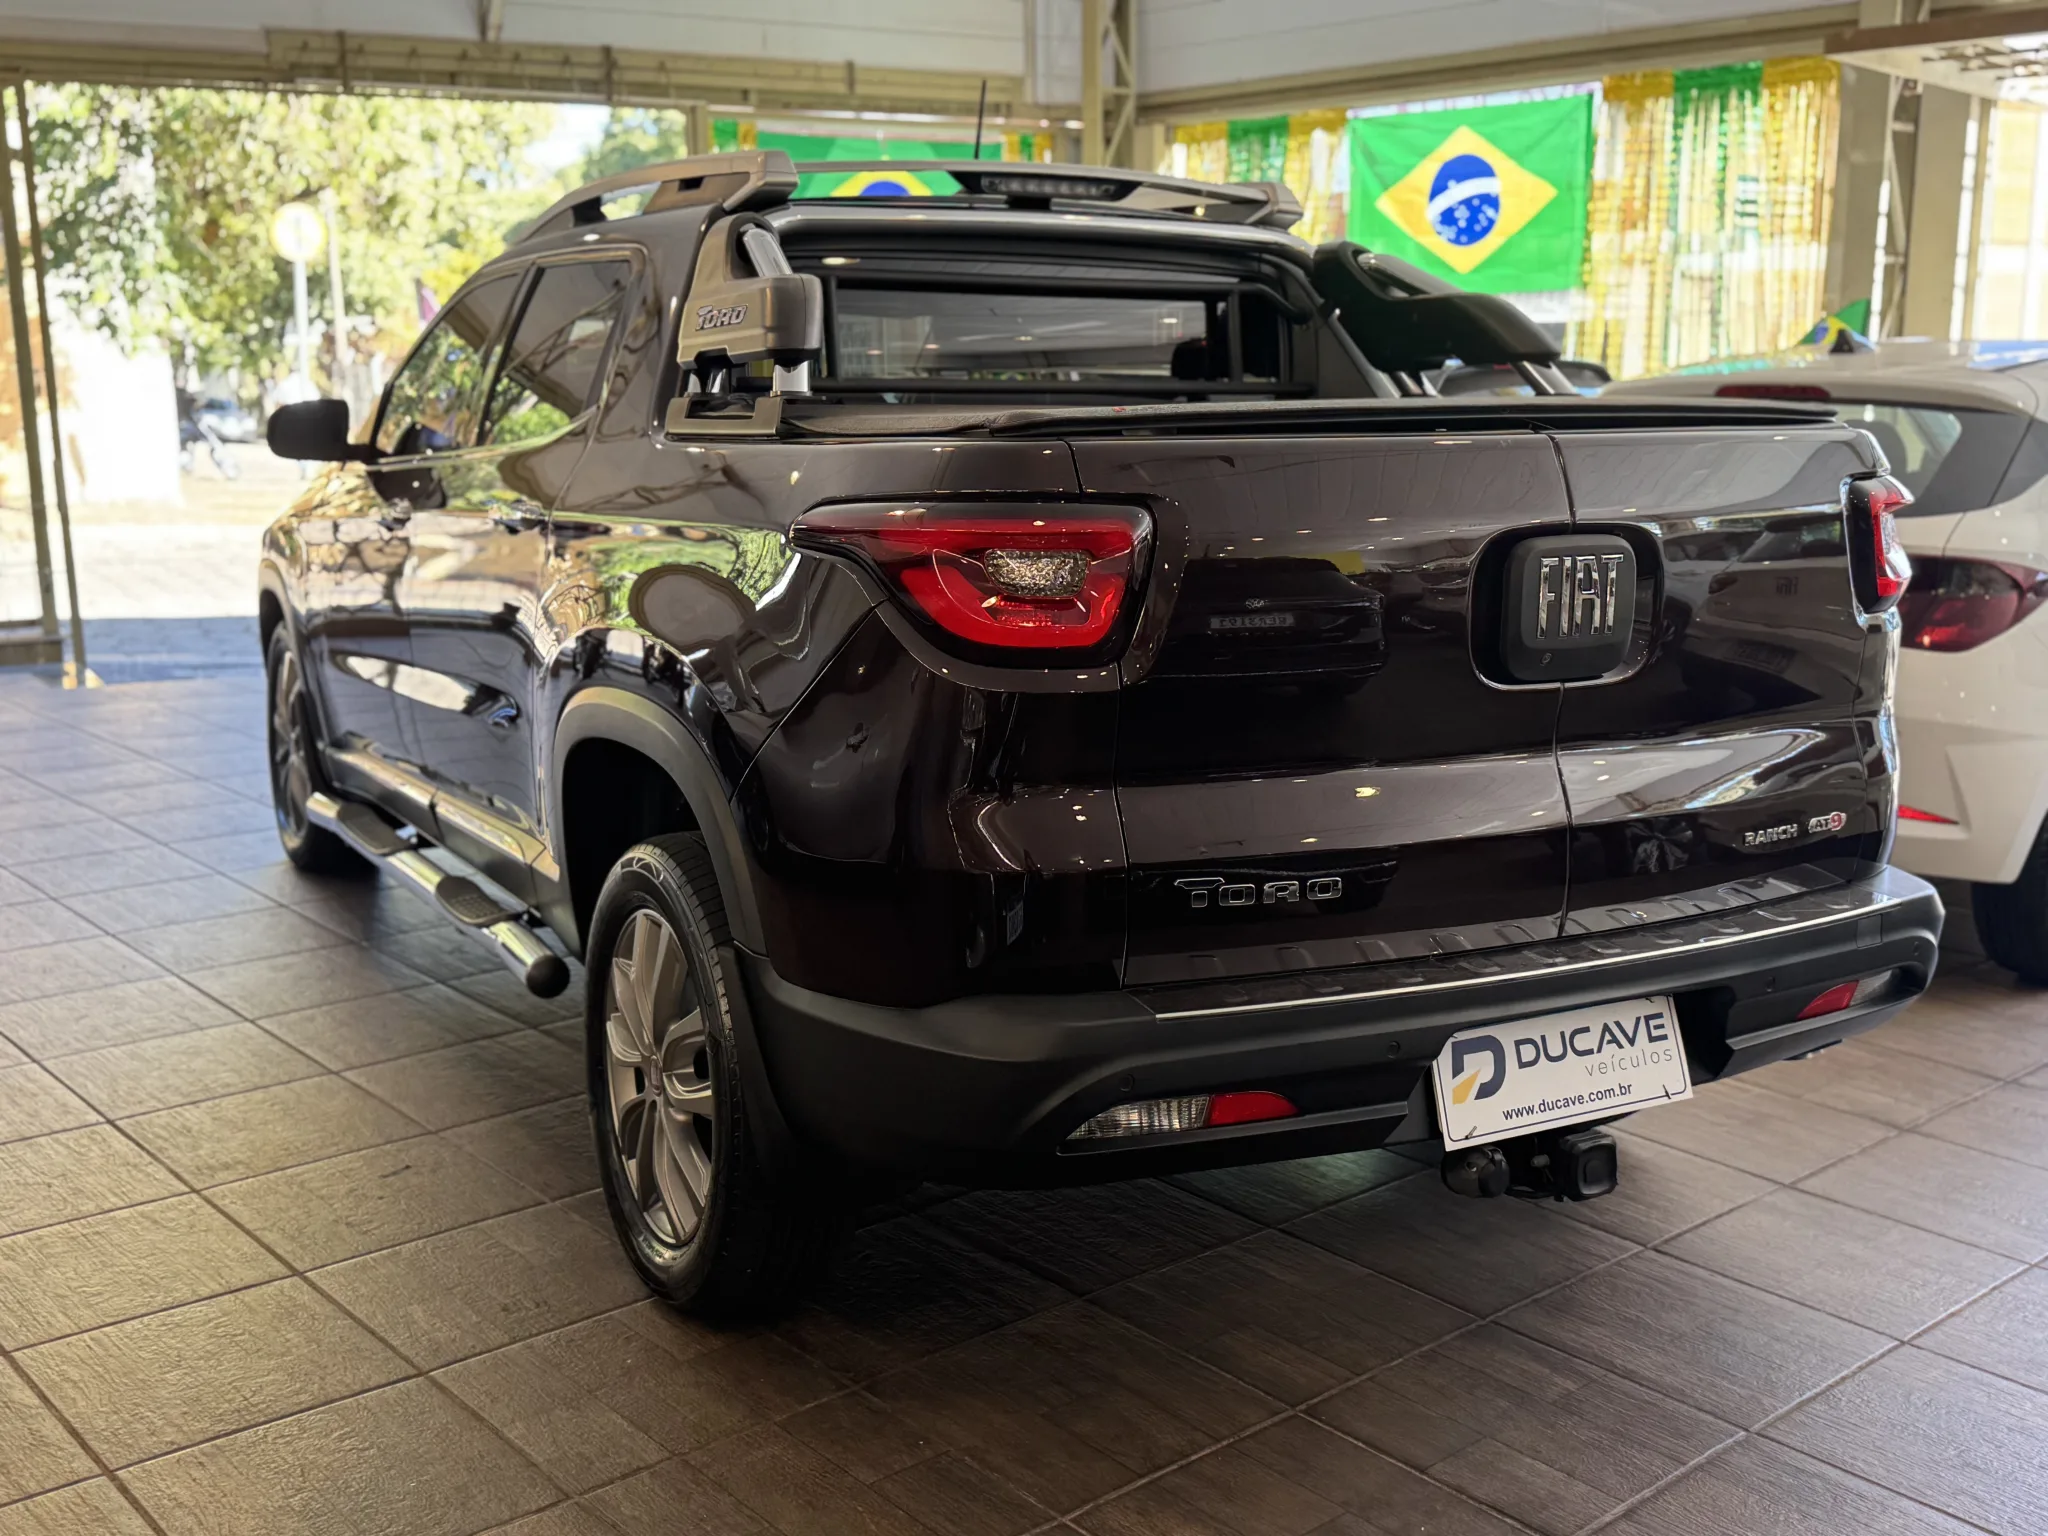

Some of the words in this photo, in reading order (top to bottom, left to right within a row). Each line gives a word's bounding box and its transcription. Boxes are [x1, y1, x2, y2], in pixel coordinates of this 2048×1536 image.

[695, 304, 749, 332] TORO
[1537, 554, 1625, 639] FIAT
[1744, 823, 1798, 846] RANCH
[1809, 811, 1846, 833] AT9
[1173, 877, 1342, 907] TORO
[1513, 1012, 1669, 1070] DUCAVE
[1584, 1047, 1673, 1077] veículos
[1502, 1083, 1633, 1121] www.ducave.com.br
